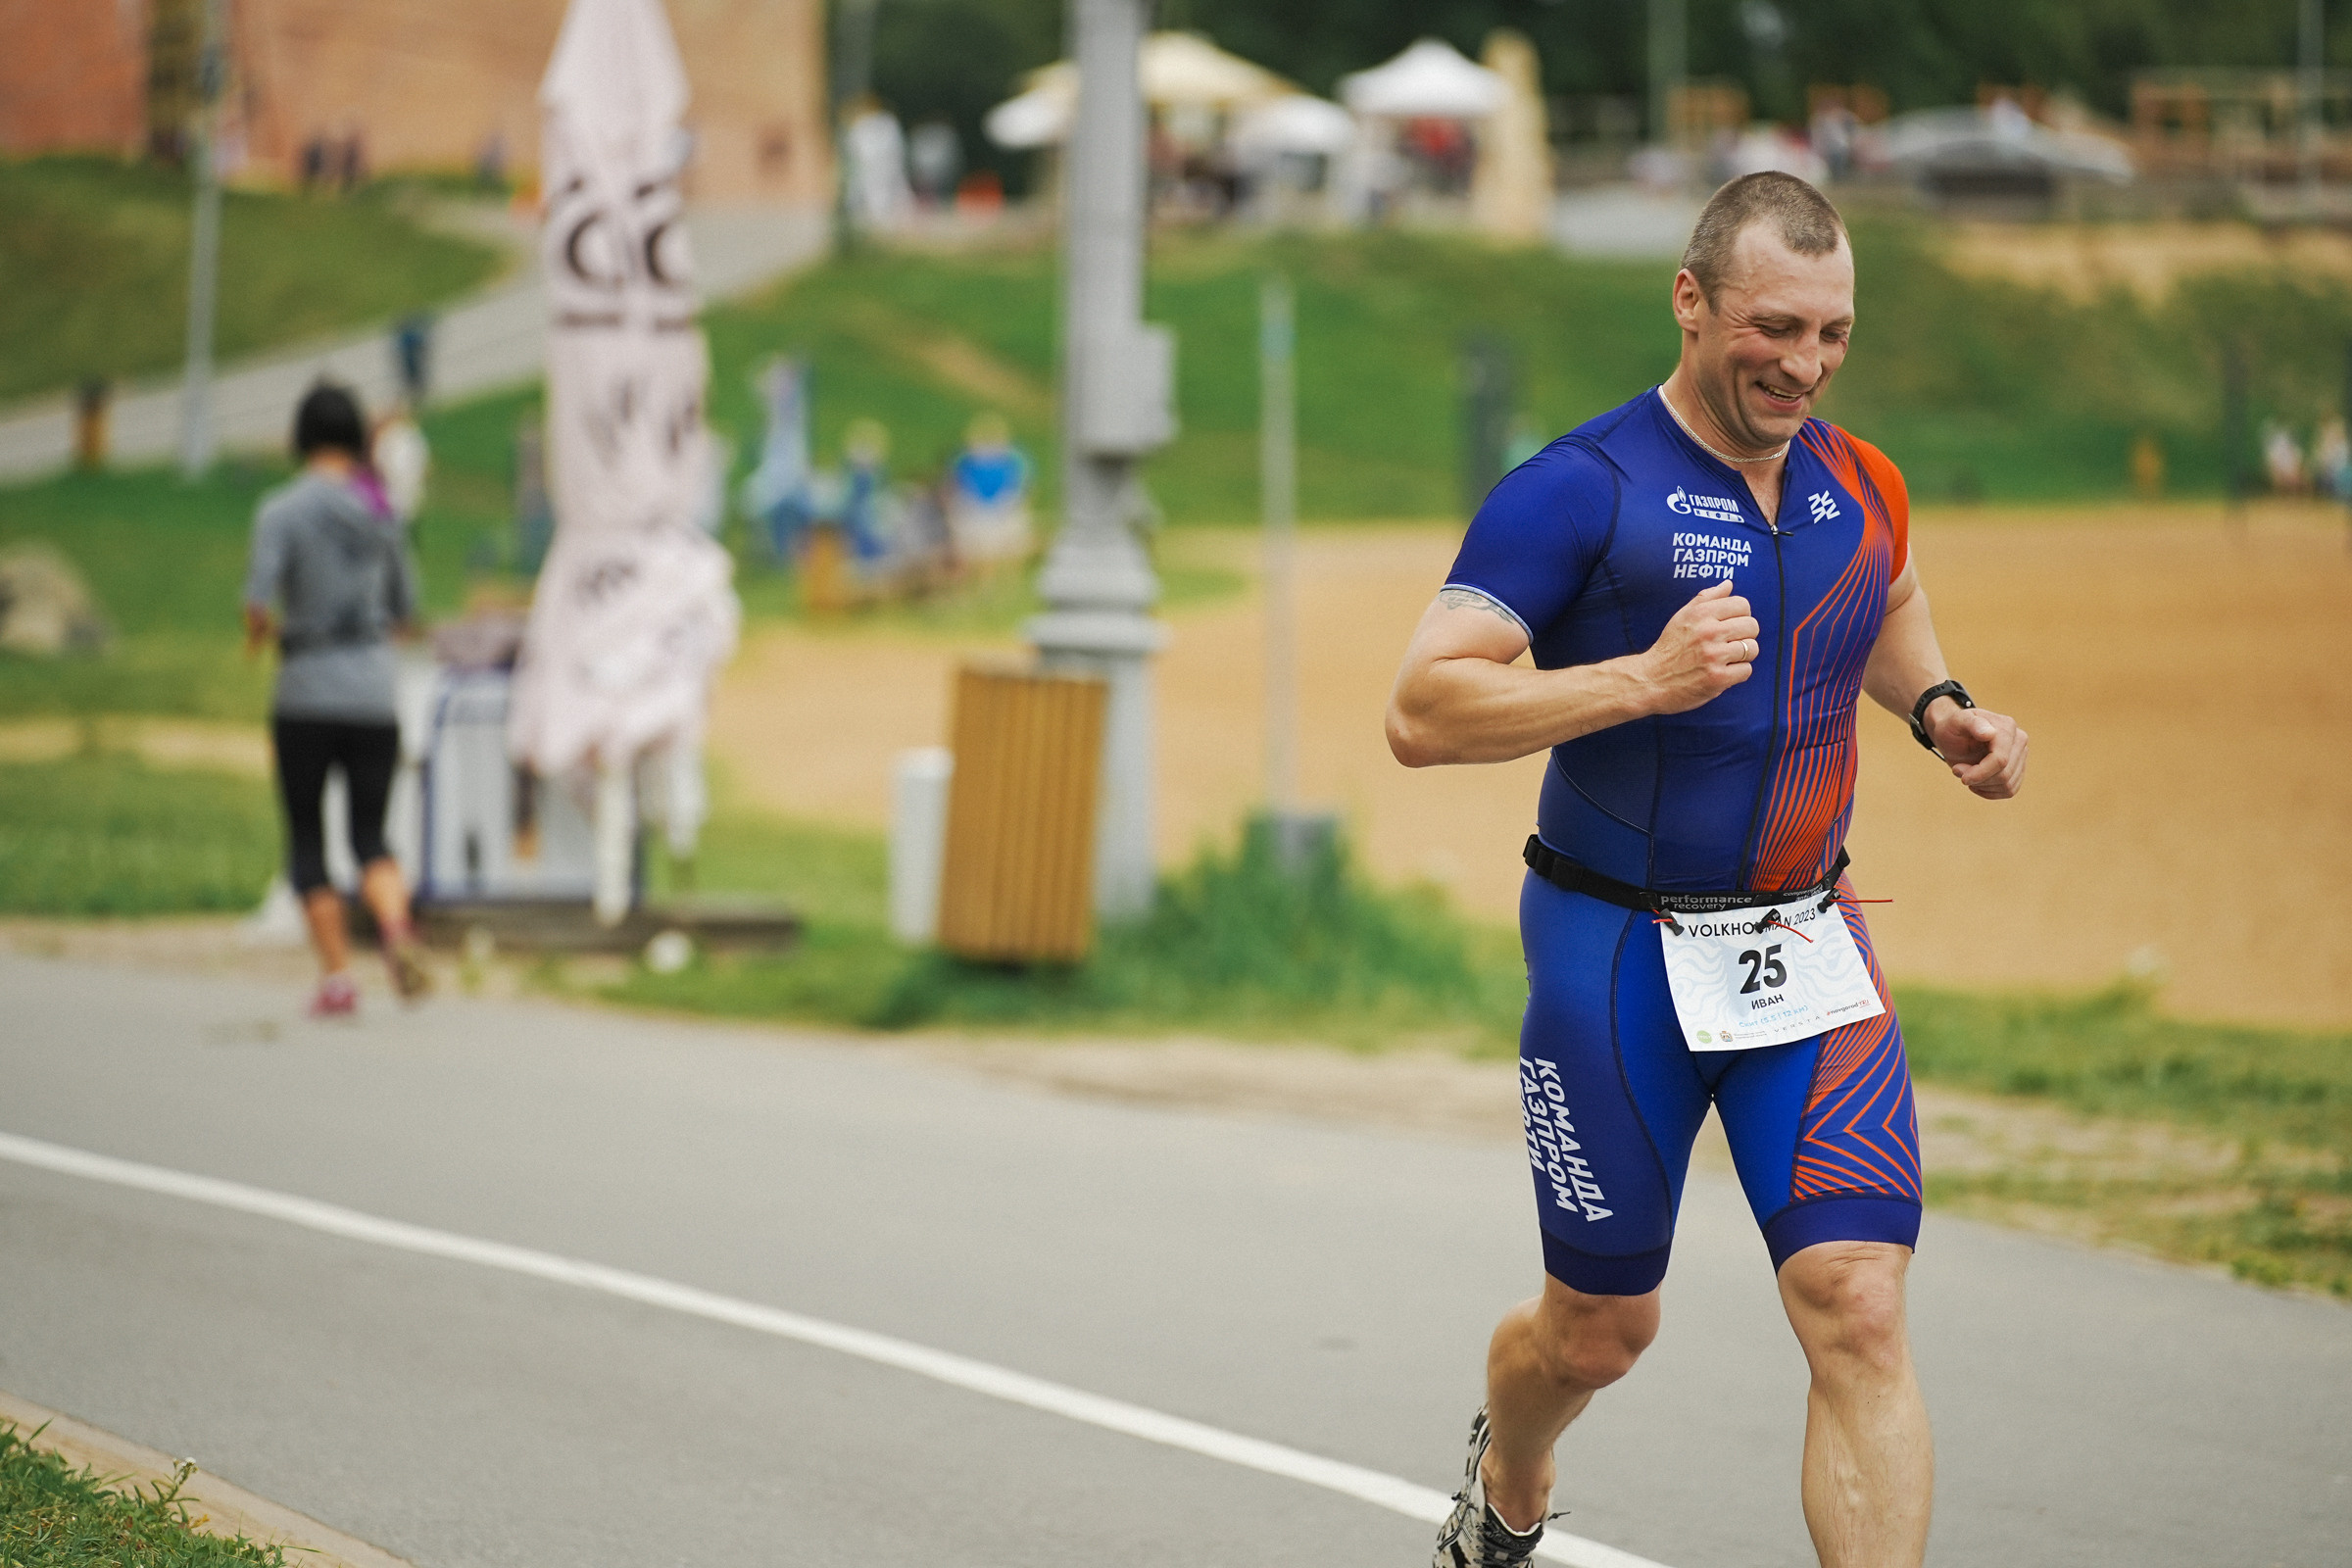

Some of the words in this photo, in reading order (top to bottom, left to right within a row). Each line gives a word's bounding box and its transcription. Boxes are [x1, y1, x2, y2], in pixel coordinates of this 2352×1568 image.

[1689, 494, 1740, 513] ГАЗПРОМ
[1694, 509, 1744, 522] НЕФТЬ
[1672, 532, 1752, 553] КОМАНДА
[1673, 548, 1749, 566] ГАЗПРОМ
[1673, 564, 1734, 579] НЕФТИ
[1660, 895, 1752, 906] performance
[1689, 915, 1791, 937] VOLKHOAN
[1793, 907, 1816, 926] 2023
[1739, 944, 1787, 994] 25
[1751, 994, 1784, 1009] ИВАН
[1520, 1055, 1579, 1213] ГАЗПРОМ
[1535, 1057, 1614, 1222] КОМАНДА
